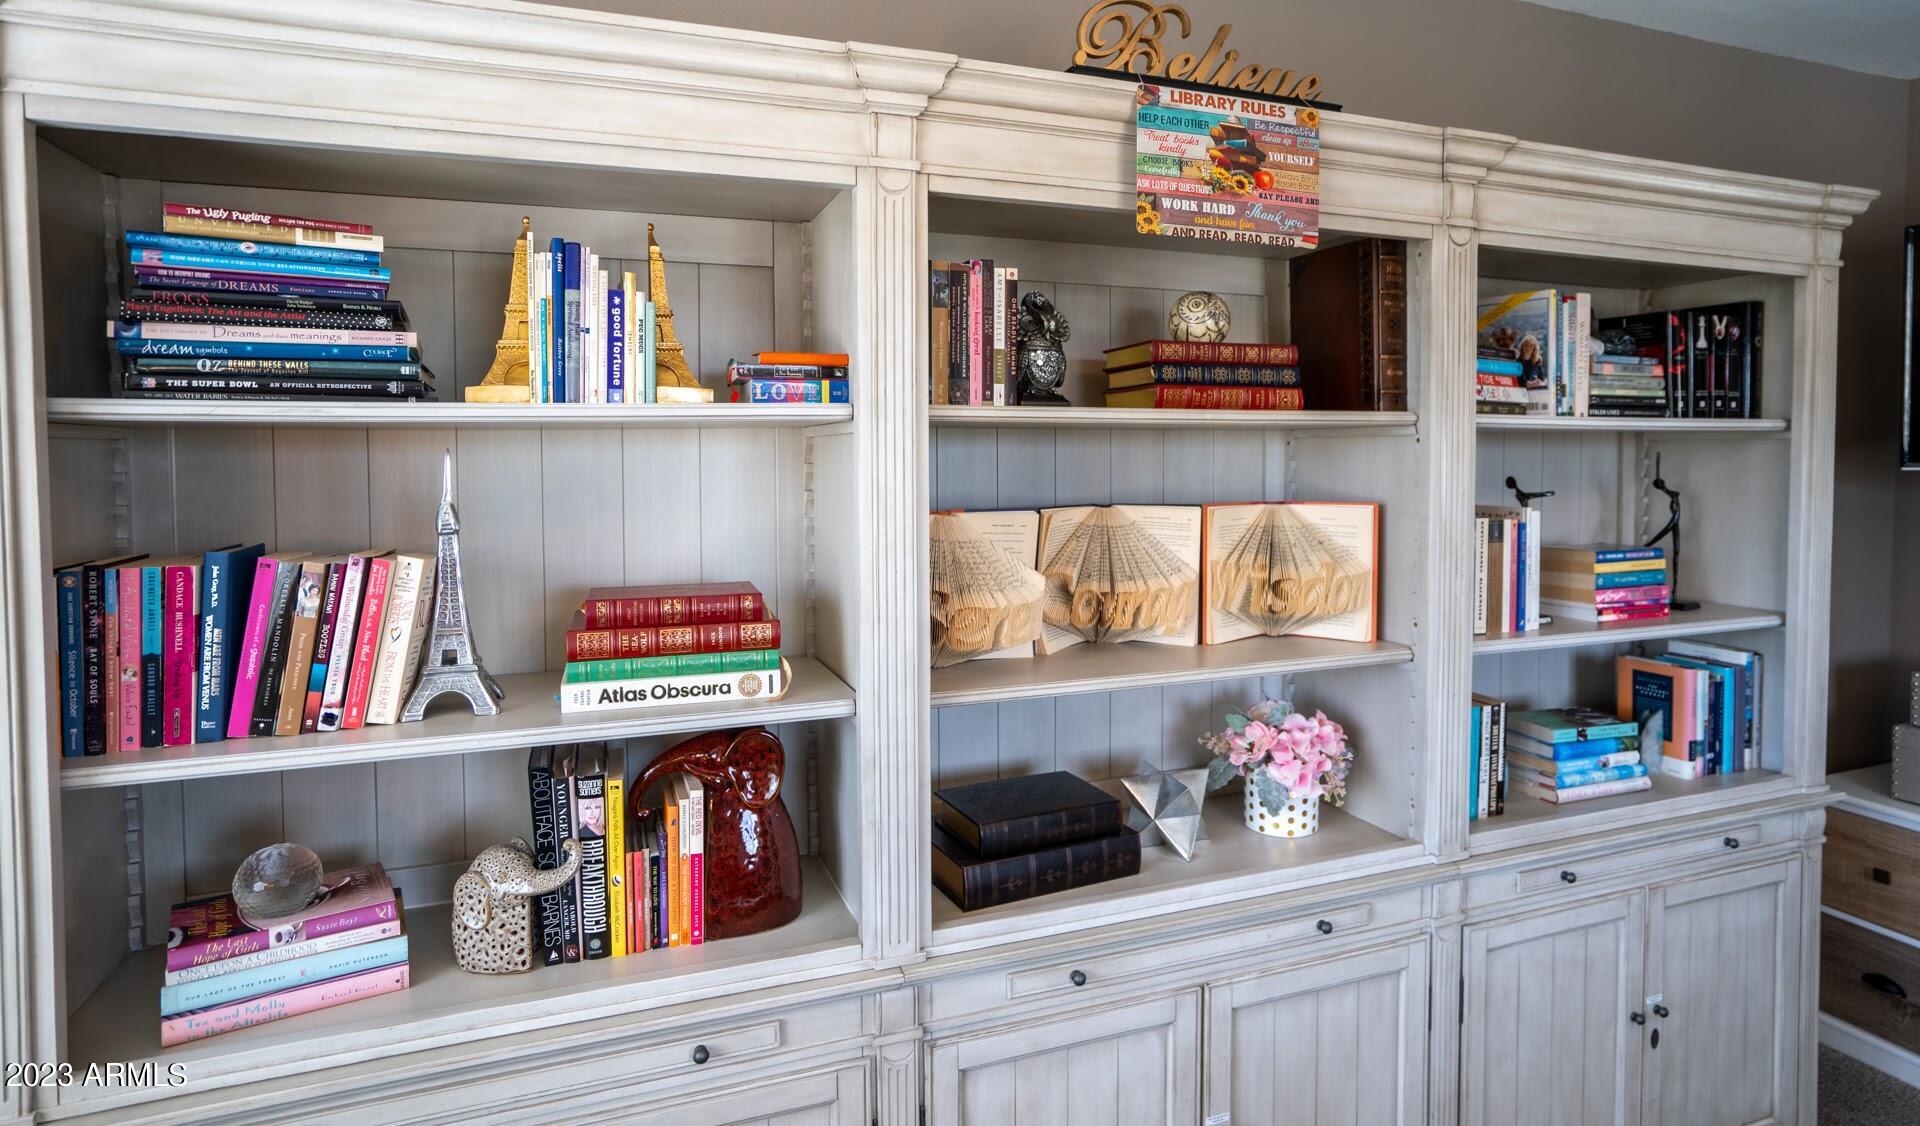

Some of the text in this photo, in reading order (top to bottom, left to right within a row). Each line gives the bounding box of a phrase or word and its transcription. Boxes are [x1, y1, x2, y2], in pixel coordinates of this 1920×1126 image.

[1073, 0, 1325, 100] Believe
[1170, 90, 1286, 119] LIBRARY RULES
[1138, 112, 1210, 129] HELP EACH OTHER
[1254, 120, 1316, 137] Be Respectful
[1144, 130, 1201, 146] Treat books
[1261, 133, 1292, 147] clean up
[1158, 142, 1187, 156] kindly
[1142, 155, 1194, 168] CHOOSE BOOKS
[1267, 151, 1315, 167] YOURSELF
[1137, 178, 1213, 194] ASK LOTS OF QUESTIONS
[1161, 197, 1236, 215] WORK HARD
[1258, 192, 1320, 206] SAY PLEASE AND
[185, 207, 271, 224] The Ugly Pugling
[1194, 215, 1256, 230] and have fun
[1245, 201, 1307, 232] Thank you
[1171, 226, 1296, 248] AND READ, READ, READ
[276, 263, 326, 272] RELATIONSHIPS
[149, 276, 279, 292] The Secret Language of DREAMS
[152, 291, 209, 303] FROGS
[126, 302, 305, 320] Mary Engelbreit: The Art and the Artist
[213, 326, 342, 344] Dreams meanings
[141, 340, 228, 356] dream symbols
[611, 307, 624, 386] good fortune
[227, 360, 256, 368] BEHIND
[259, 360, 281, 369] THESE
[285, 361, 309, 370] WALLS
[166, 379, 188, 387] THE
[191, 379, 226, 387] SUPER
[229, 380, 259, 388] BOWL
[754, 382, 819, 401] LOVE
[211, 565, 220, 578] John
[174, 571, 184, 654] CANDACE BUSHNELL
[88, 571, 98, 704] ROBERT STONE BAY OF SOULS
[270, 617, 283, 662] MANDOLIN
[317, 624, 331, 659] BOOTLEG
[621, 634, 629, 652] THE
[640, 631, 648, 654] WOLF
[68, 649, 77, 679] Silence
[201, 614, 214, 710] WOMEN ARE FROM VENUS
[210, 628, 222, 696] MEN ARE FROM MARS
[245, 647, 258, 680] Shopaholic
[597, 681, 732, 705] Atlas Obscura
[69, 689, 79, 718] October
[577, 778, 603, 789] suzanne
[579, 787, 602, 797] somers
[556, 783, 569, 839] YOUNGER
[695, 796, 703, 836] THE RED DEVIL
[580, 839, 607, 934] BREAKTHROUGH
[315, 916, 358, 932] Susie Boyt
[541, 894, 562, 947] BARNES
[569, 904, 577, 933] HAROLD
[192, 942, 260, 966] Hope of Girls
[205, 936, 249, 954] The Last
